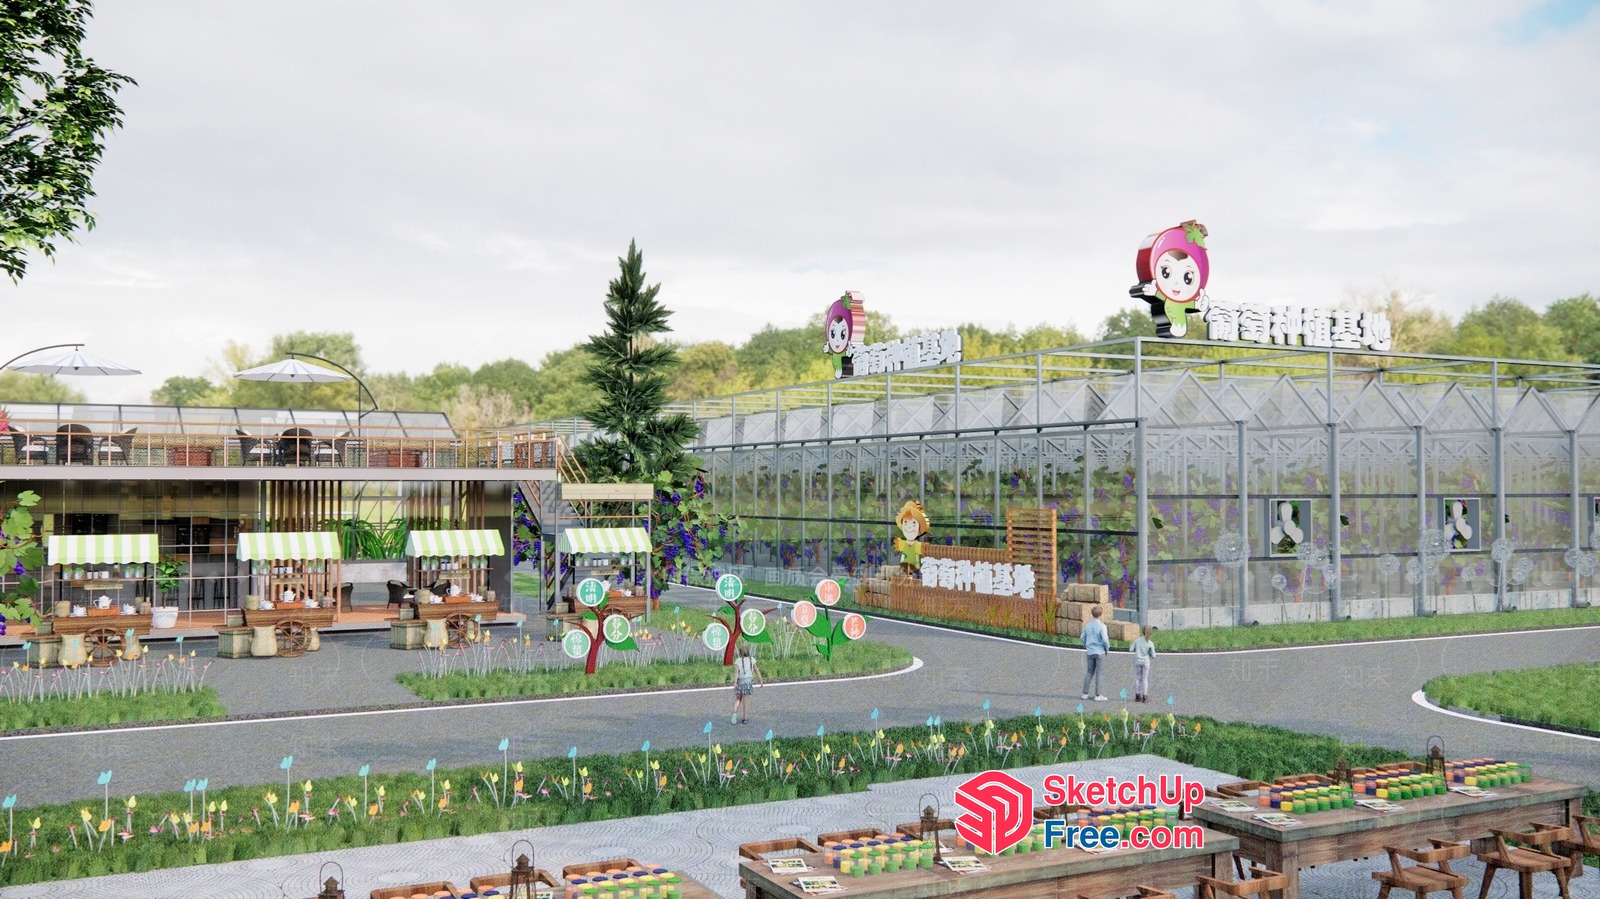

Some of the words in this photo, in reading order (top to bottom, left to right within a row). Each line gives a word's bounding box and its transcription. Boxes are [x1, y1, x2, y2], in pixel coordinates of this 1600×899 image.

[1204, 299, 1391, 351] 葡萄种植基地
[585, 581, 597, 603] 清明
[724, 576, 735, 598] 清明
